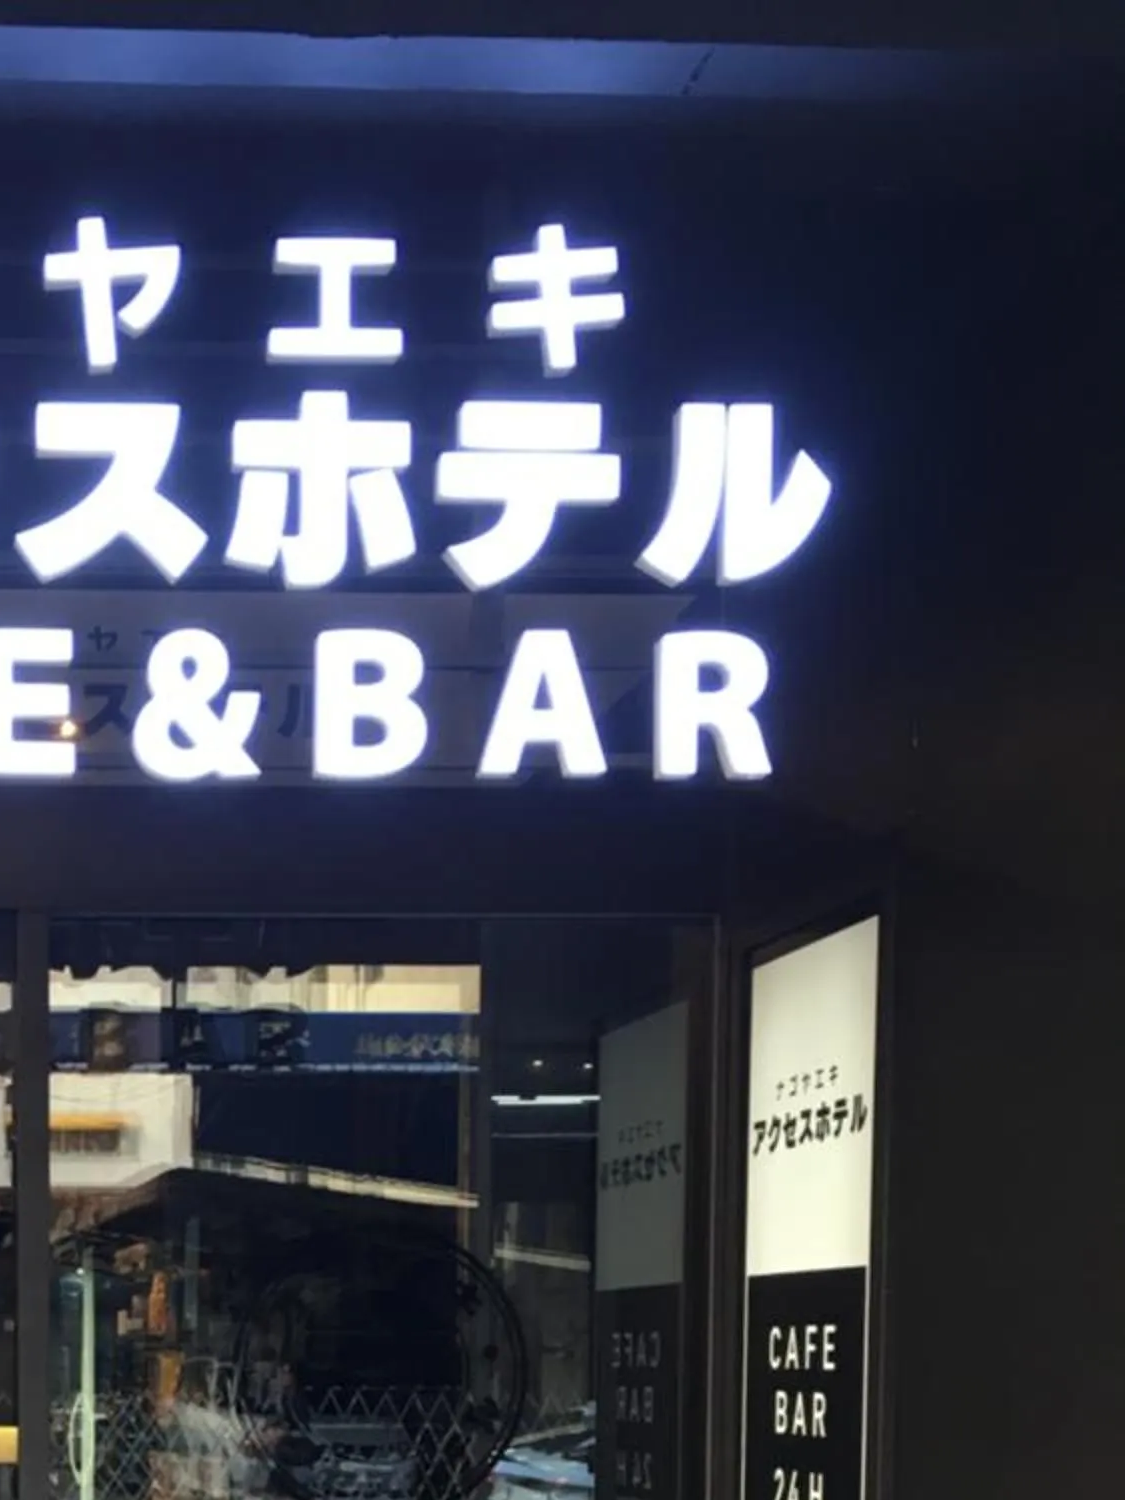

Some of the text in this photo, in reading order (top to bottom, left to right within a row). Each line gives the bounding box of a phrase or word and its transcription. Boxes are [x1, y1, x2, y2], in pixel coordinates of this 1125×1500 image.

[752, 1093, 868, 1156] アクセスホテル
[768, 1324, 837, 1370] CAFE
[775, 1389, 827, 1438] BAR
